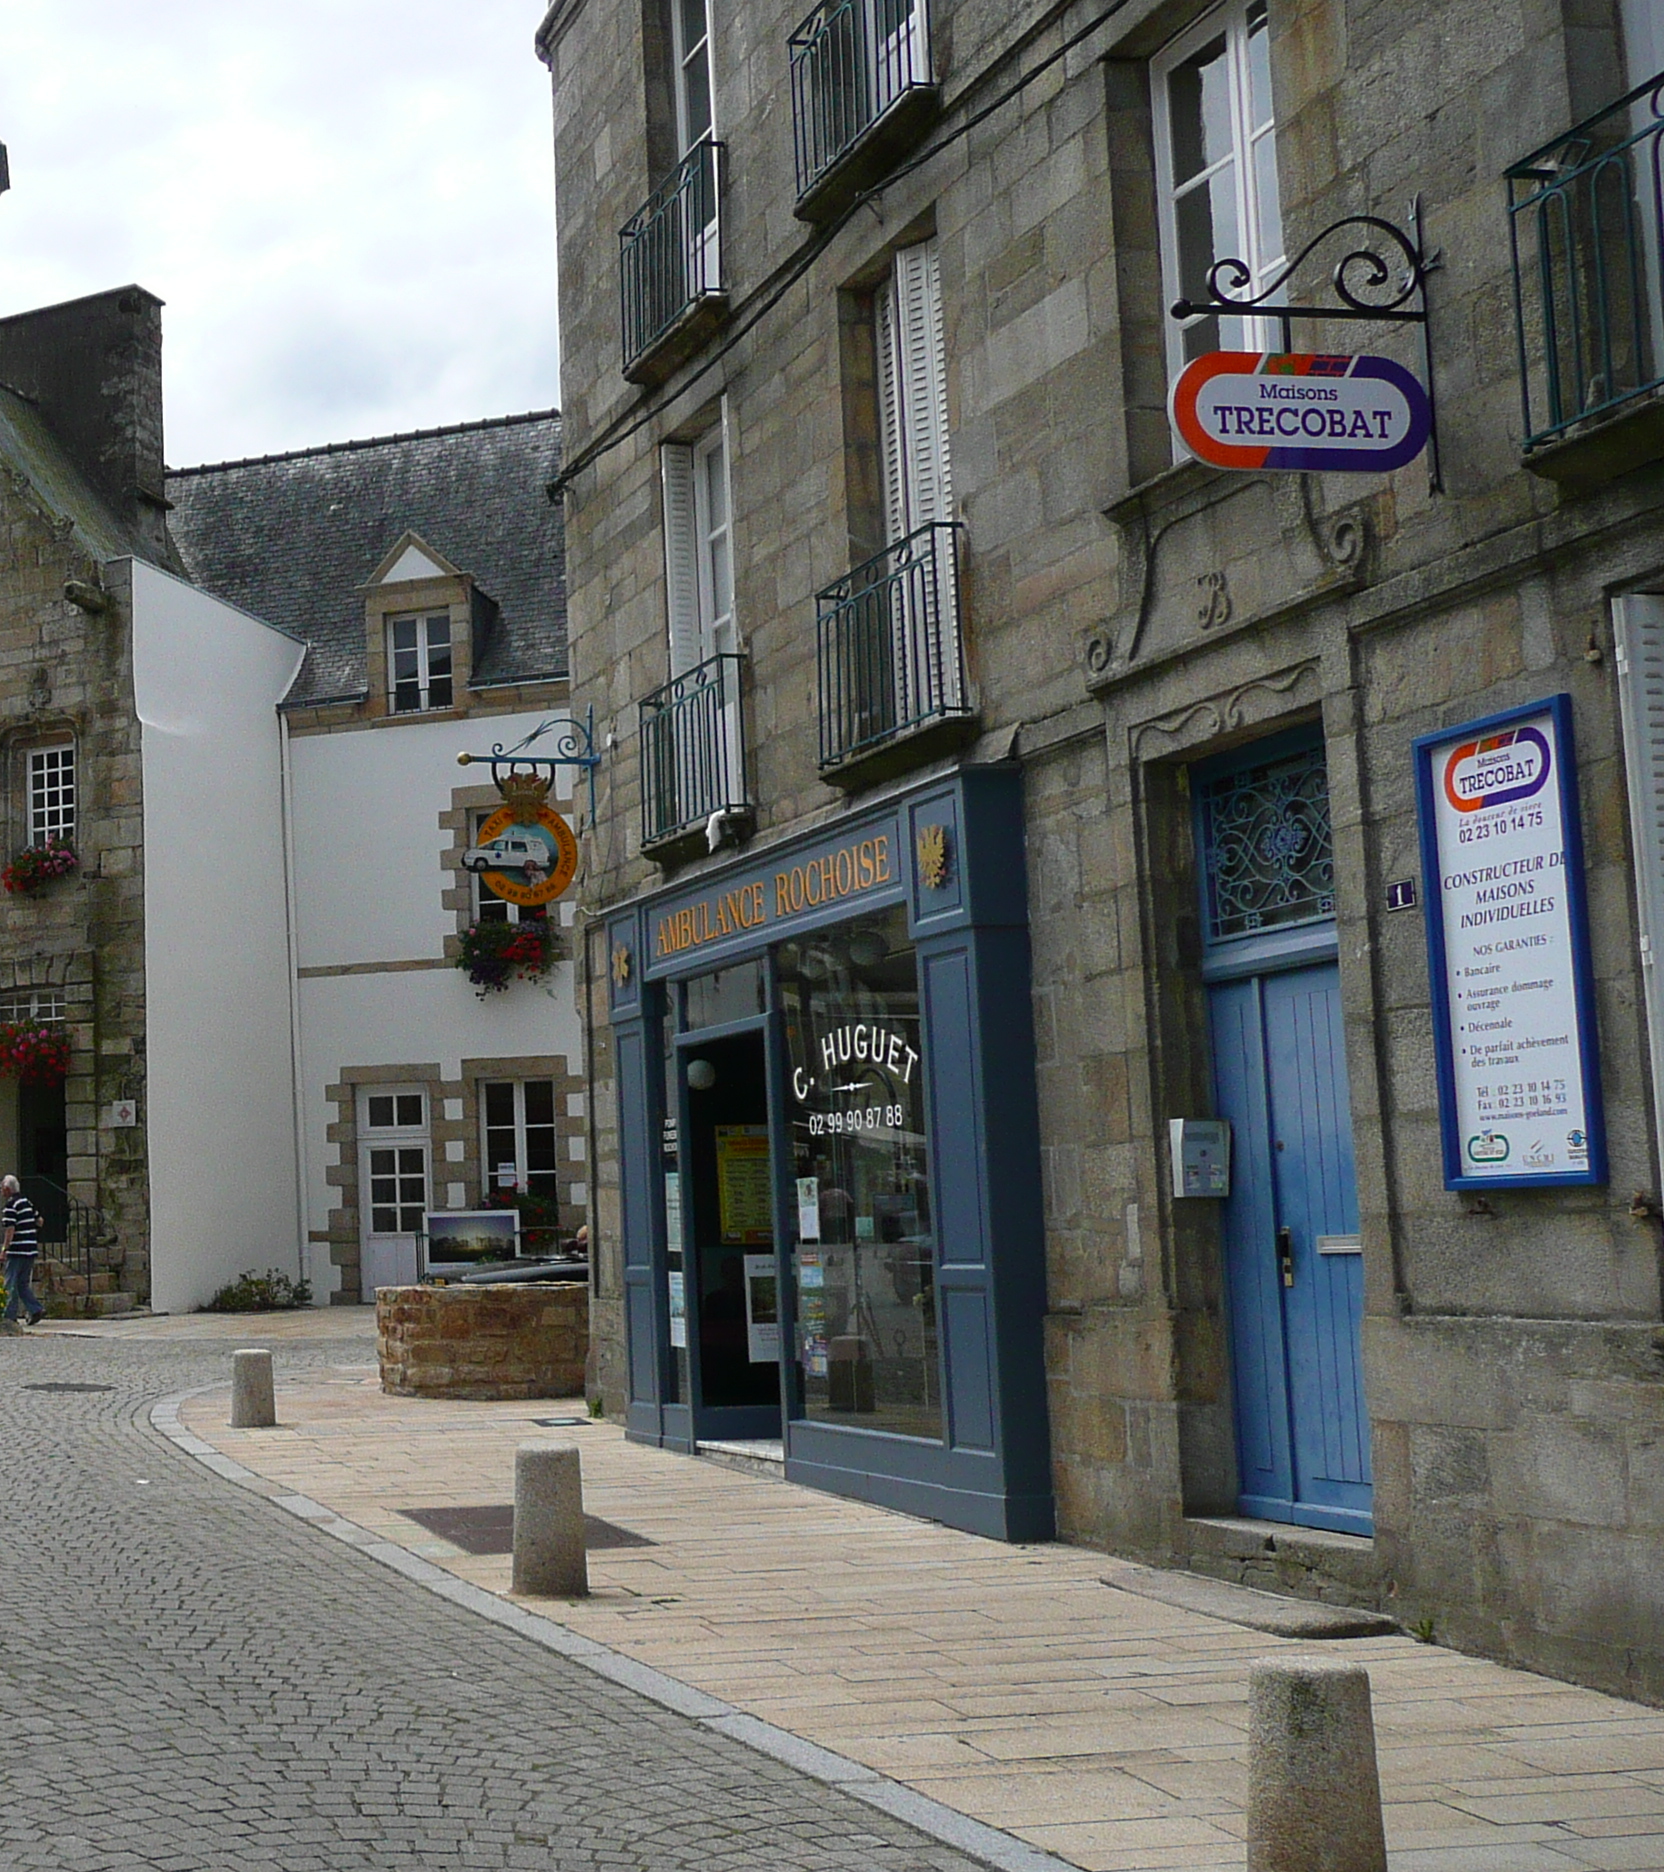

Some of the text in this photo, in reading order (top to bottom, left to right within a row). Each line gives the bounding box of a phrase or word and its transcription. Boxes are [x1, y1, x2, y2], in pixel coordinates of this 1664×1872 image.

[1259, 384, 1338, 401] Maisons
[1213, 405, 1392, 439] TRECOBAT
[1477, 753, 1511, 768] Maisons
[1459, 759, 1534, 794] TRECOBAT
[484, 817, 504, 837] TAXI
[1459, 811, 1543, 844] 02 23 10 14 75
[548, 819, 570, 877] AMBULANCE
[1444, 855, 1544, 890] CONSTRUCTEUR
[656, 836, 890, 957] AMBULANCE ROCHOISE
[1396, 884, 1404, 906] 1
[1475, 879, 1535, 905] MAISONS
[1460, 896, 1555, 929] INDIVIDUELLES
[1473, 944, 1493, 957] NOS
[1495, 934, 1547, 953] GARANTIES
[1464, 963, 1501, 977] Bancaire
[1466, 978, 1554, 999] Assurance dommage
[1467, 999, 1501, 1011] ouvrage
[1468, 1017, 1513, 1033] Décennale
[821, 1024, 919, 1085] HUGUET
[1470, 1034, 1569, 1056] De parfait achèvement
[1471, 1055, 1519, 1068] des travaux
[1498, 1084, 1509, 1096] 02
[1512, 1083, 1524, 1094] 23
[1527, 1082, 1537, 1092] 10
[1540, 1080, 1550, 1092] 14
[1553, 1078, 1566, 1090] 75
[1498, 1098, 1510, 1109] 02
[1513, 1096, 1525, 1107] 23
[1529, 1095, 1539, 1105] 10
[809, 1104, 903, 1136] 02 99 90 87 88
